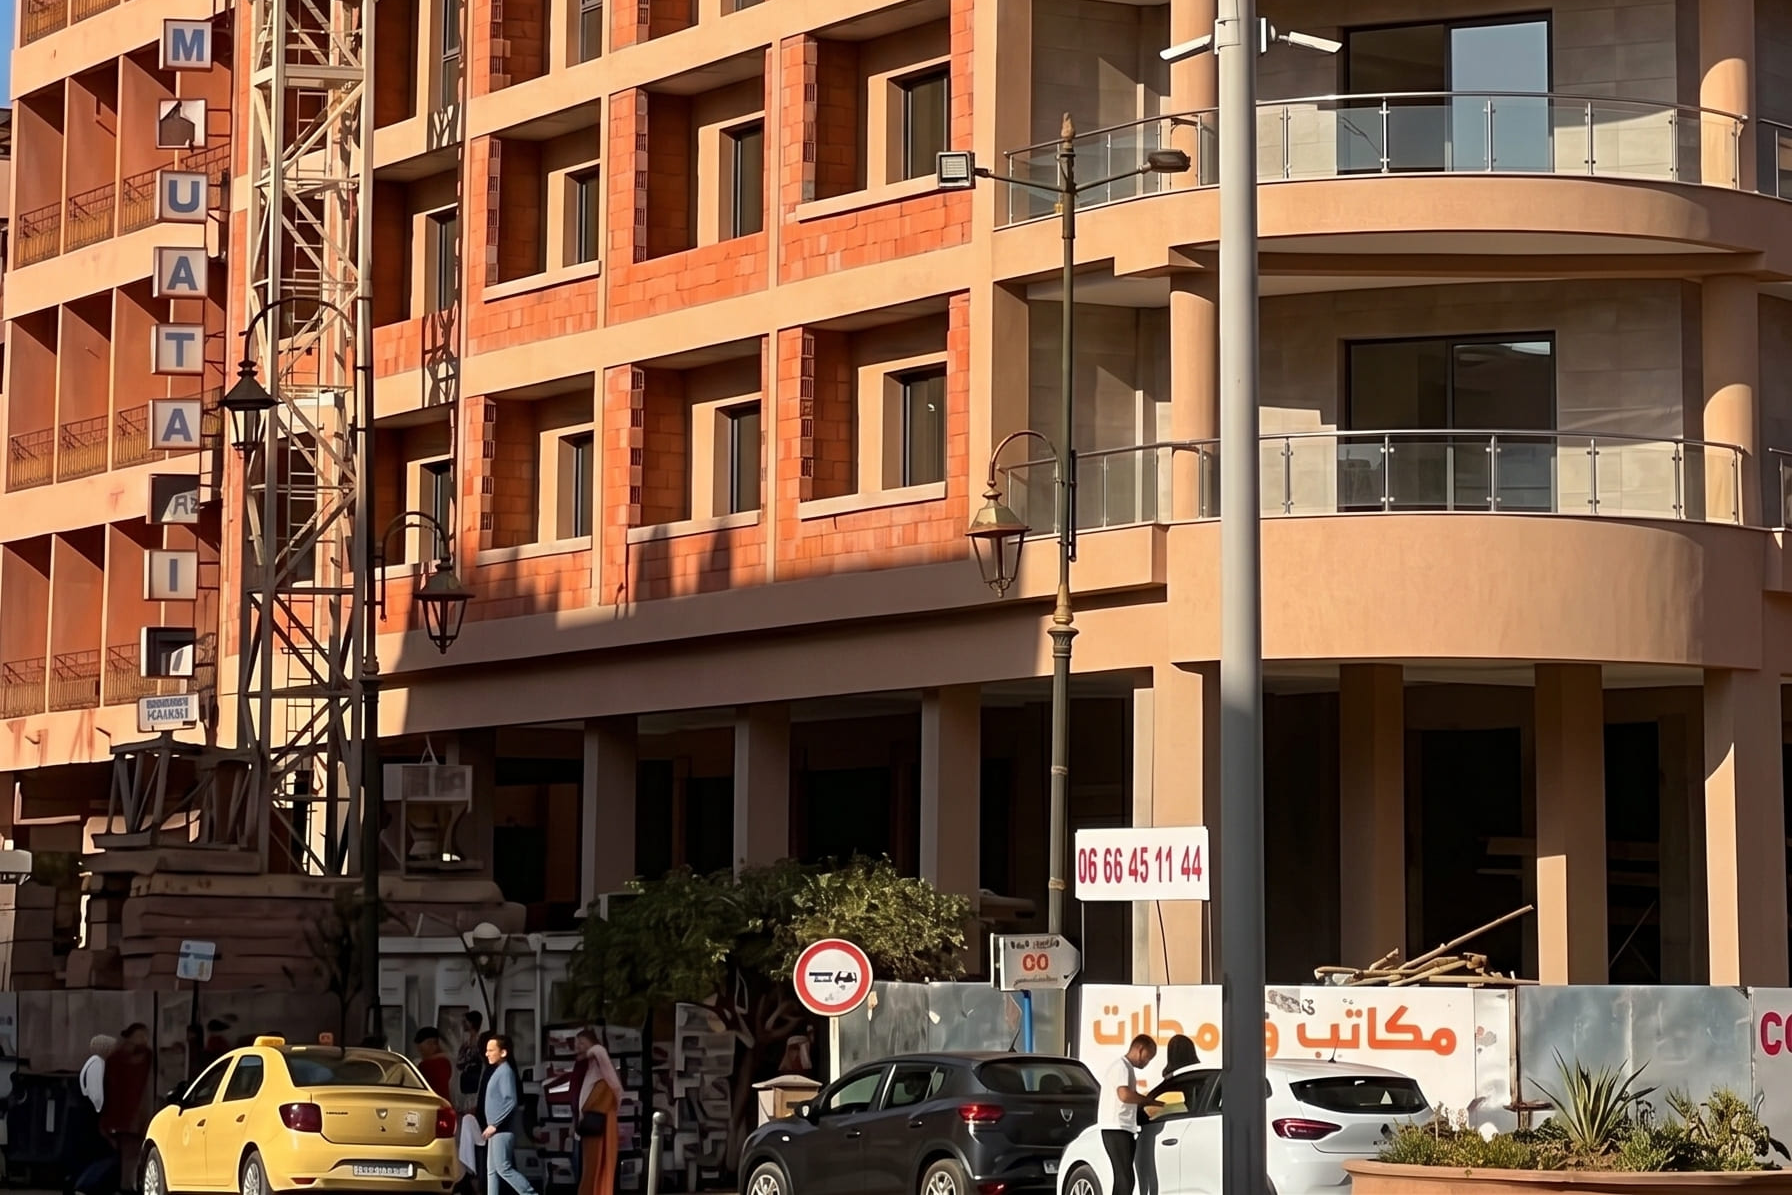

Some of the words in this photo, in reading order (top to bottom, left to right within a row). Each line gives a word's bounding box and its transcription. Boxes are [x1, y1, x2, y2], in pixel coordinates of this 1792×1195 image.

[1078, 847, 1098, 884] 06
[1104, 847, 1123, 884] 66
[1128, 846, 1149, 884] 45
[1155, 845, 1173, 883] 11
[1181, 844, 1203, 882] 44
[1296, 1005, 1457, 1059] مكاتب
